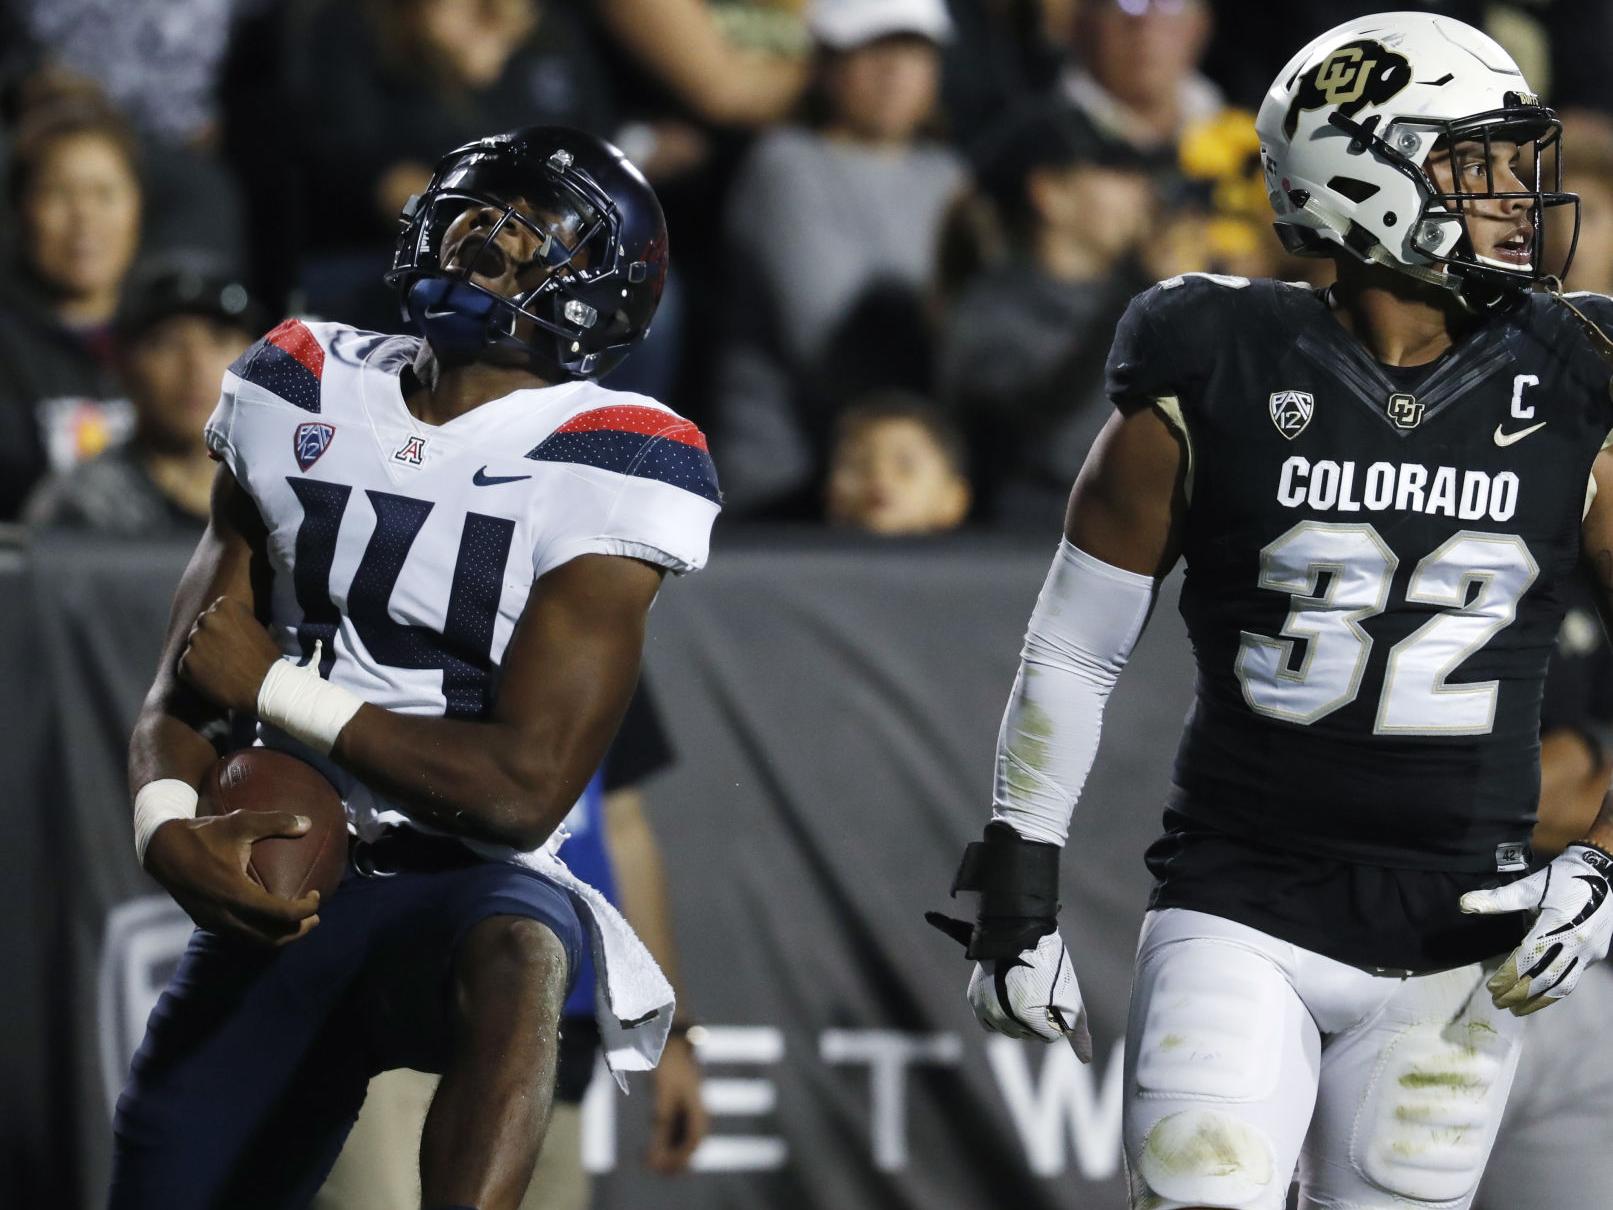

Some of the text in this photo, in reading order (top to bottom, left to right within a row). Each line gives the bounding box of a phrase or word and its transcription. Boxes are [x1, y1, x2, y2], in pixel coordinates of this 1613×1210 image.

[1314, 47, 1377, 104] CU
[1273, 392, 1312, 421] PAC
[1387, 393, 1425, 429] CU
[1510, 374, 1540, 419] C
[1280, 411, 1301, 429] 12
[301, 442, 321, 460] 12
[395, 436, 425, 465] A
[1276, 455, 1520, 522] COLORADO
[285, 476, 516, 719] 14
[1234, 519, 1540, 736] 32
